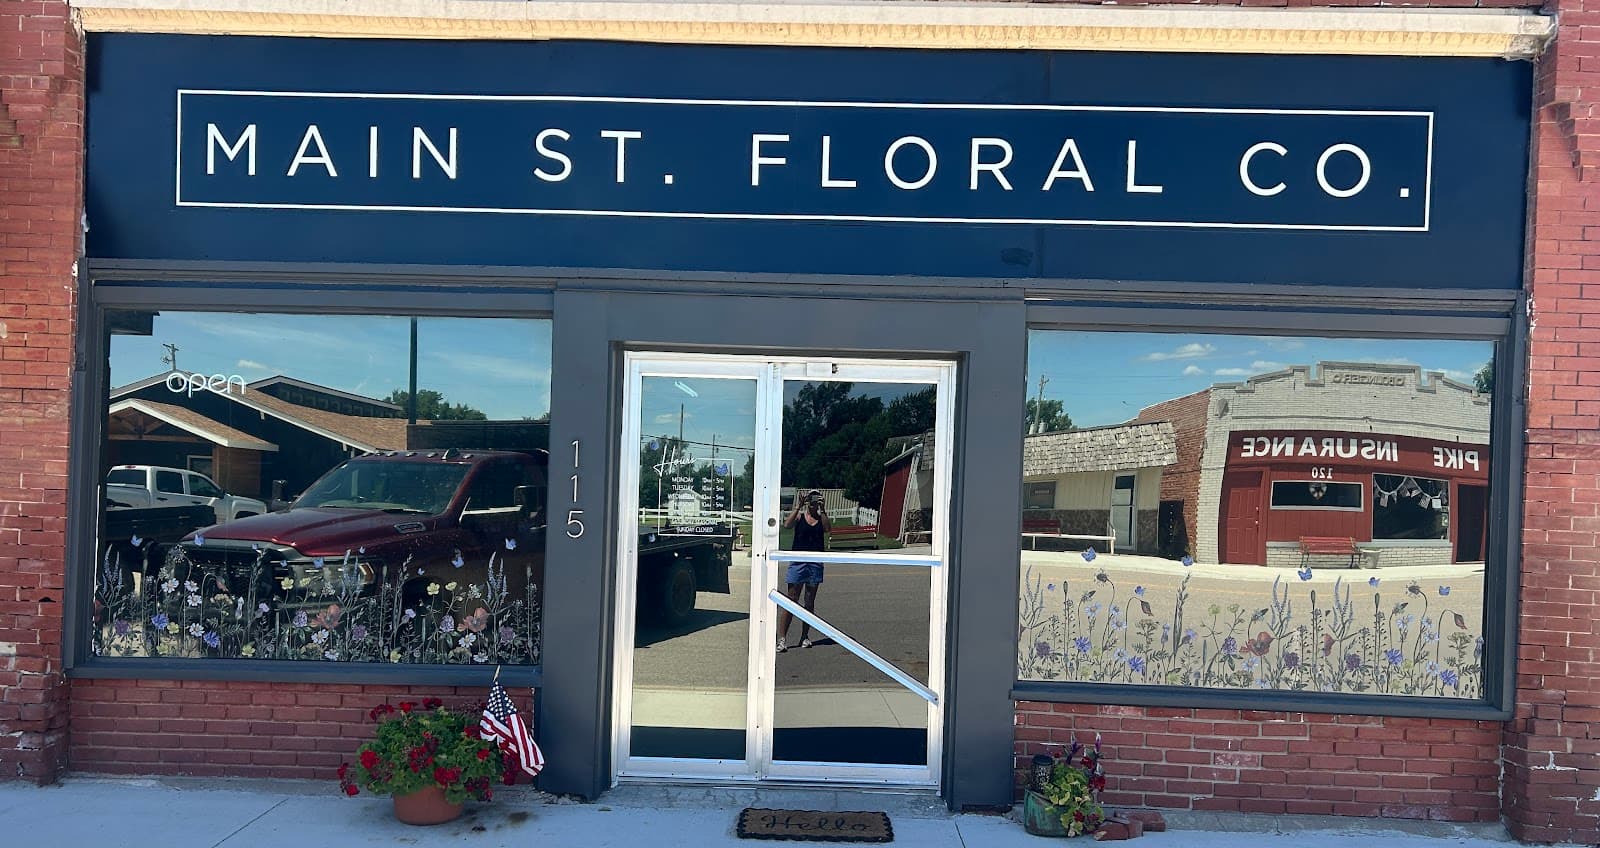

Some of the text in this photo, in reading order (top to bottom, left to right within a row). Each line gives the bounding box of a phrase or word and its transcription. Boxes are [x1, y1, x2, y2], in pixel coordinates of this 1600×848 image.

[206, 123, 1410, 198] MAIN ST. FLORAL CO.
[166, 372, 245, 398] open
[653, 444, 697, 477] Hours
[566, 440, 584, 538] 115
[761, 815, 870, 831] Hello
